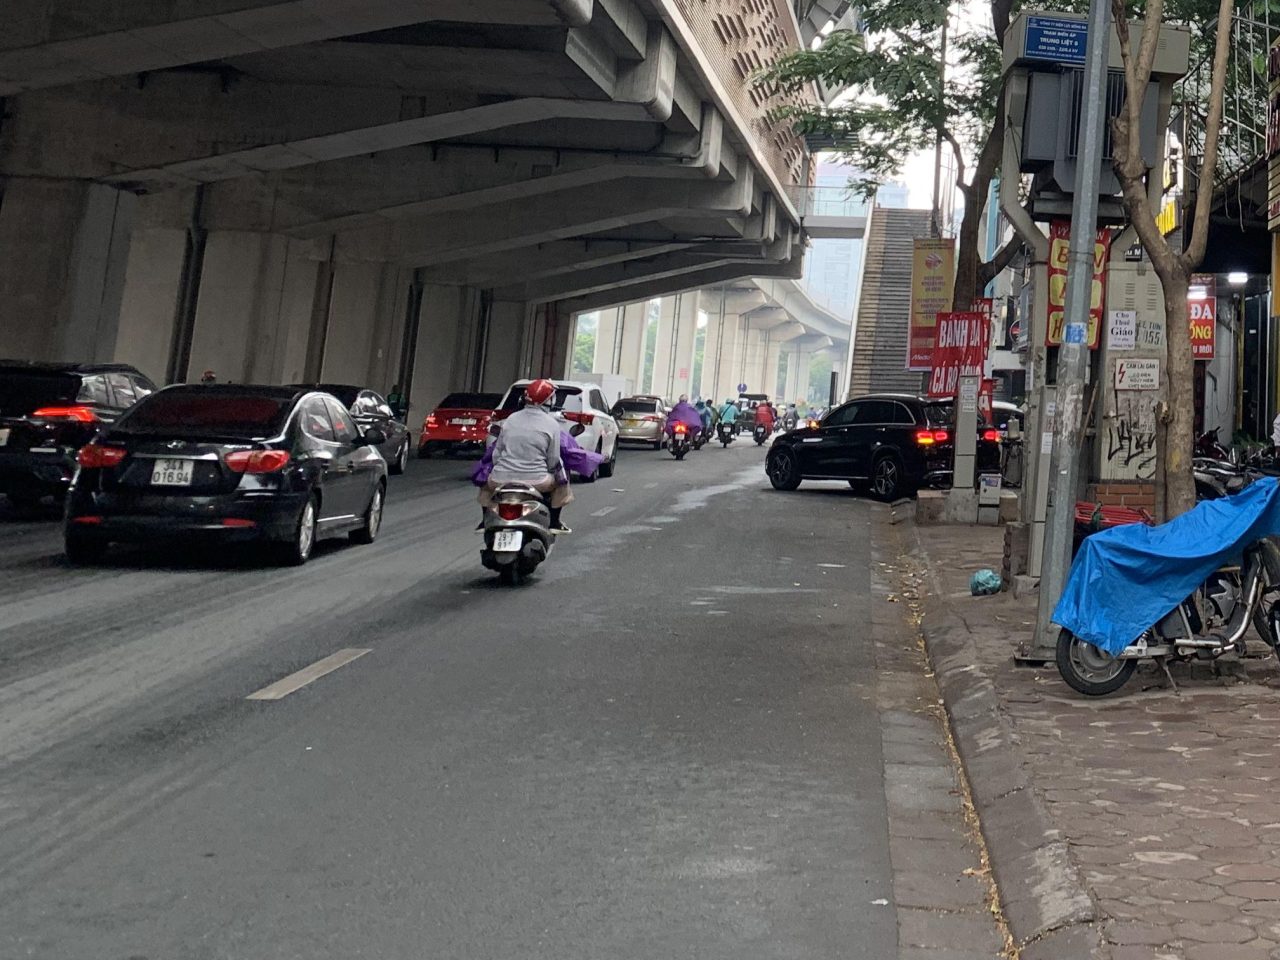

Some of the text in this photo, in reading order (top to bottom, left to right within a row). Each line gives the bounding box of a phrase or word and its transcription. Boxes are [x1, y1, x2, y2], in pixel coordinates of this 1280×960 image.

[1040, 37, 1060, 45] TRUNG
[1190, 303, 1214, 320] ĐA
[938, 314, 969, 348] BÁNH
[1110, 325, 1134, 337] Giáo
[932, 360, 946, 394] CÁ
[162, 460, 185, 472] 34A
